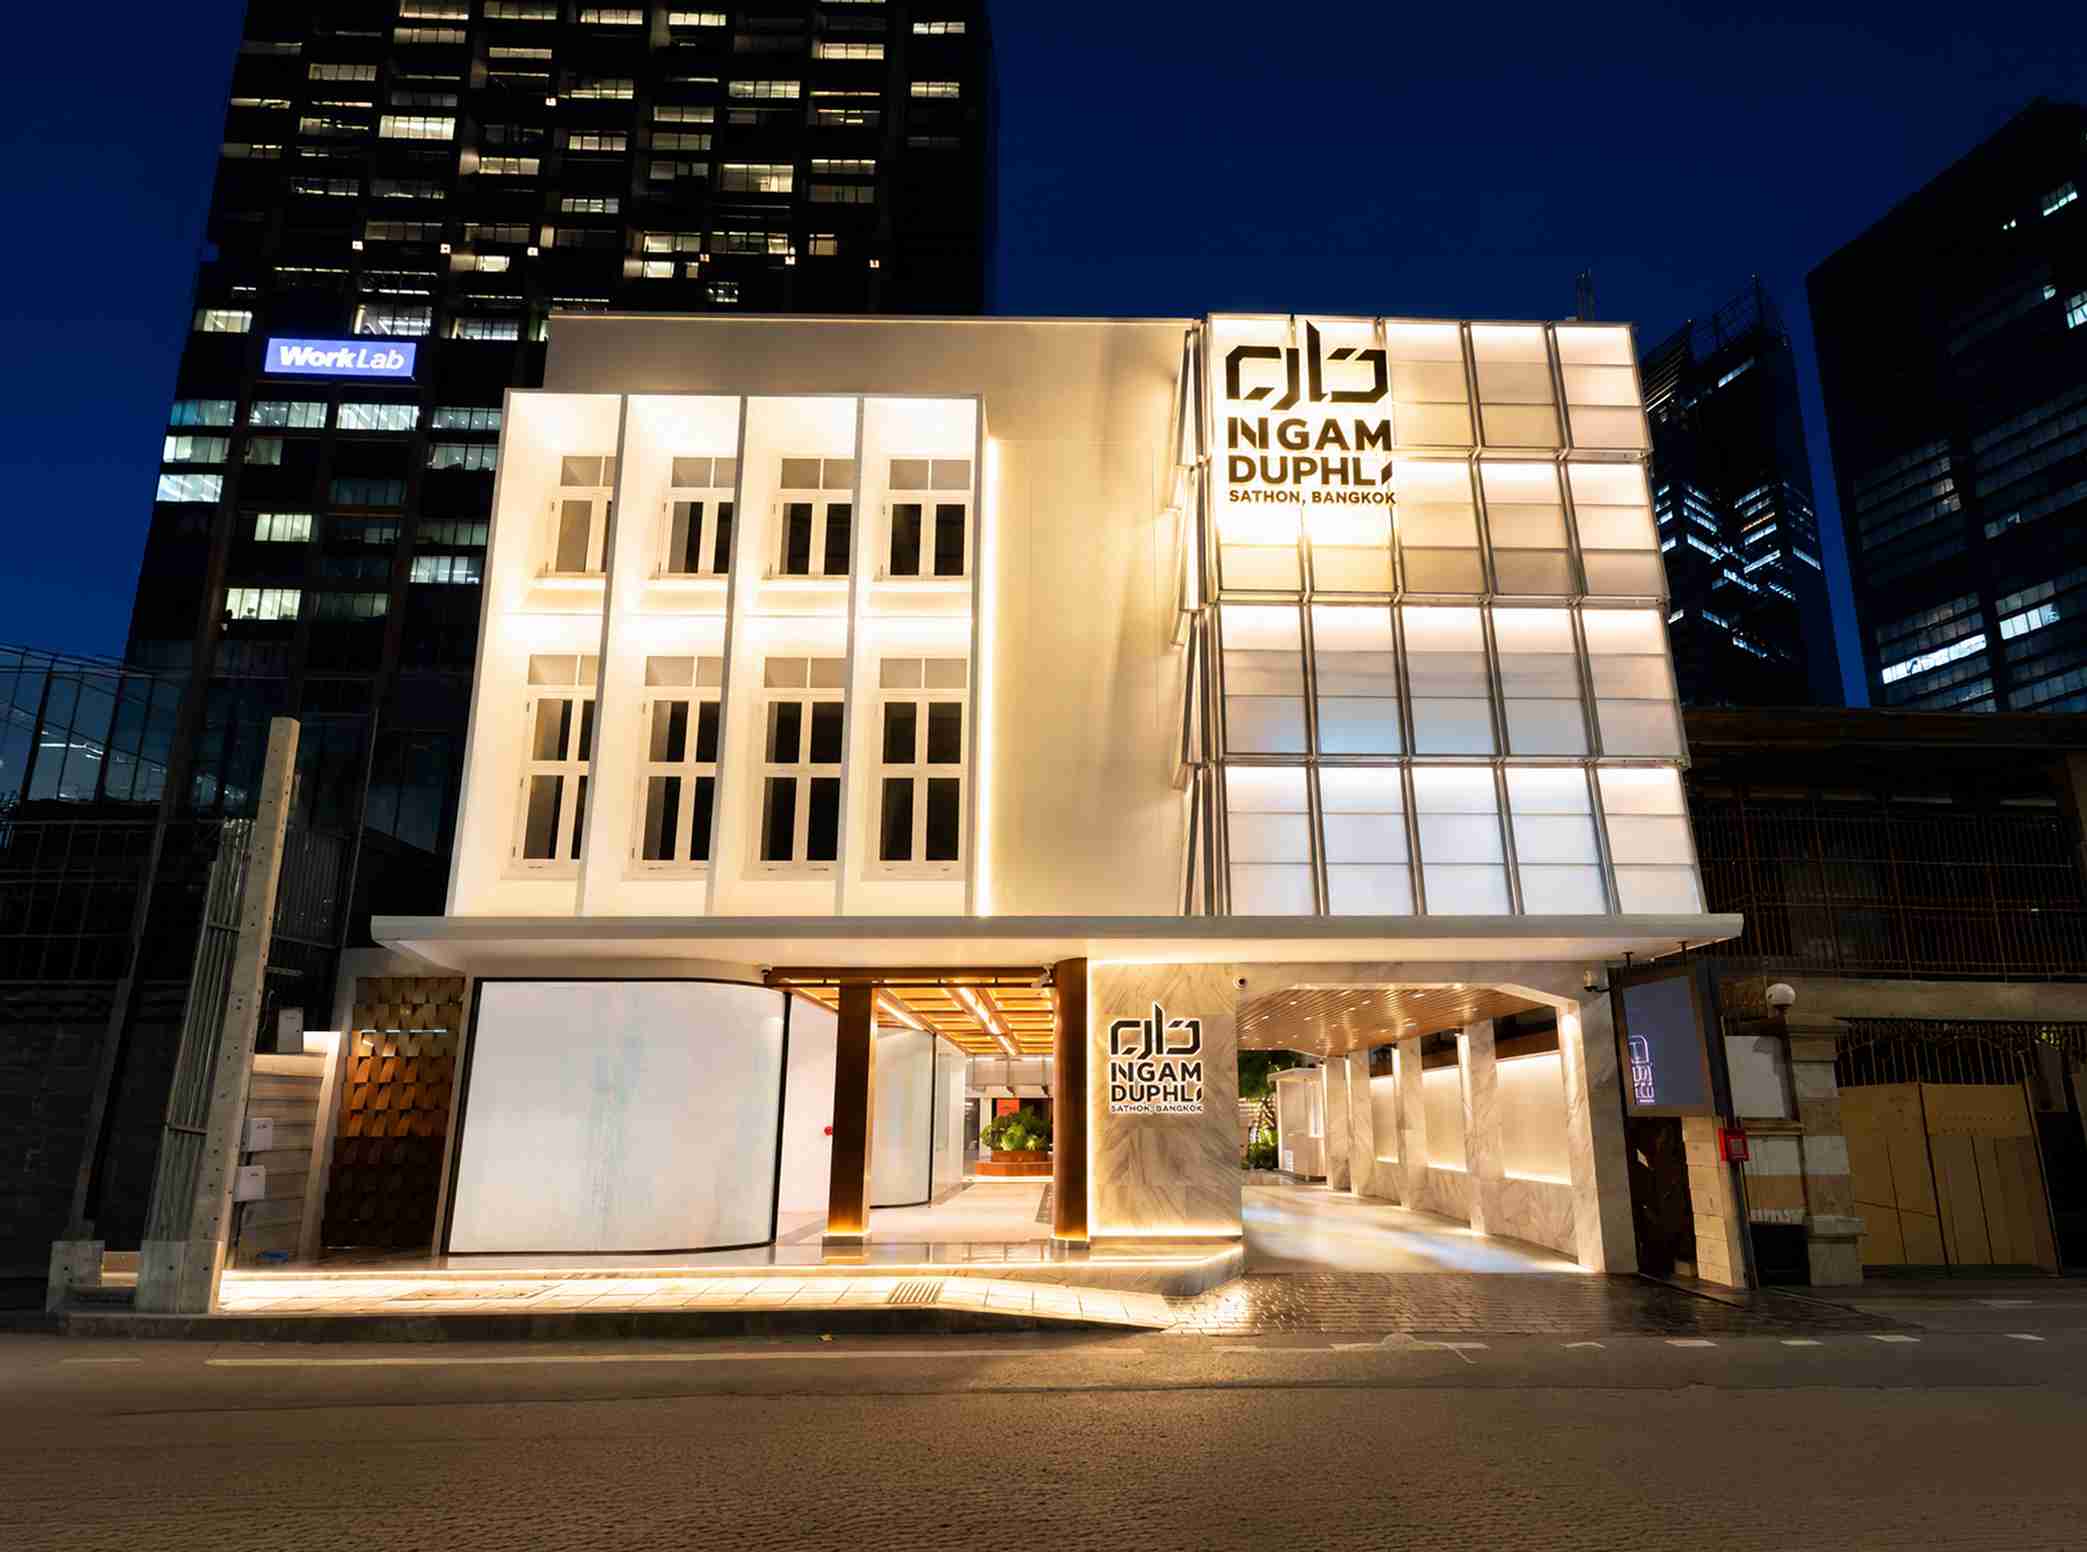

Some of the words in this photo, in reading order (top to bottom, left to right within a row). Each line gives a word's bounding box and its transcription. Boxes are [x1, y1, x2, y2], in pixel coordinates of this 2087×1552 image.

[1227, 416, 1392, 451] NGAM
[1311, 491, 1397, 505] BANGKOK
[1110, 1062, 1202, 1082] NGAM
